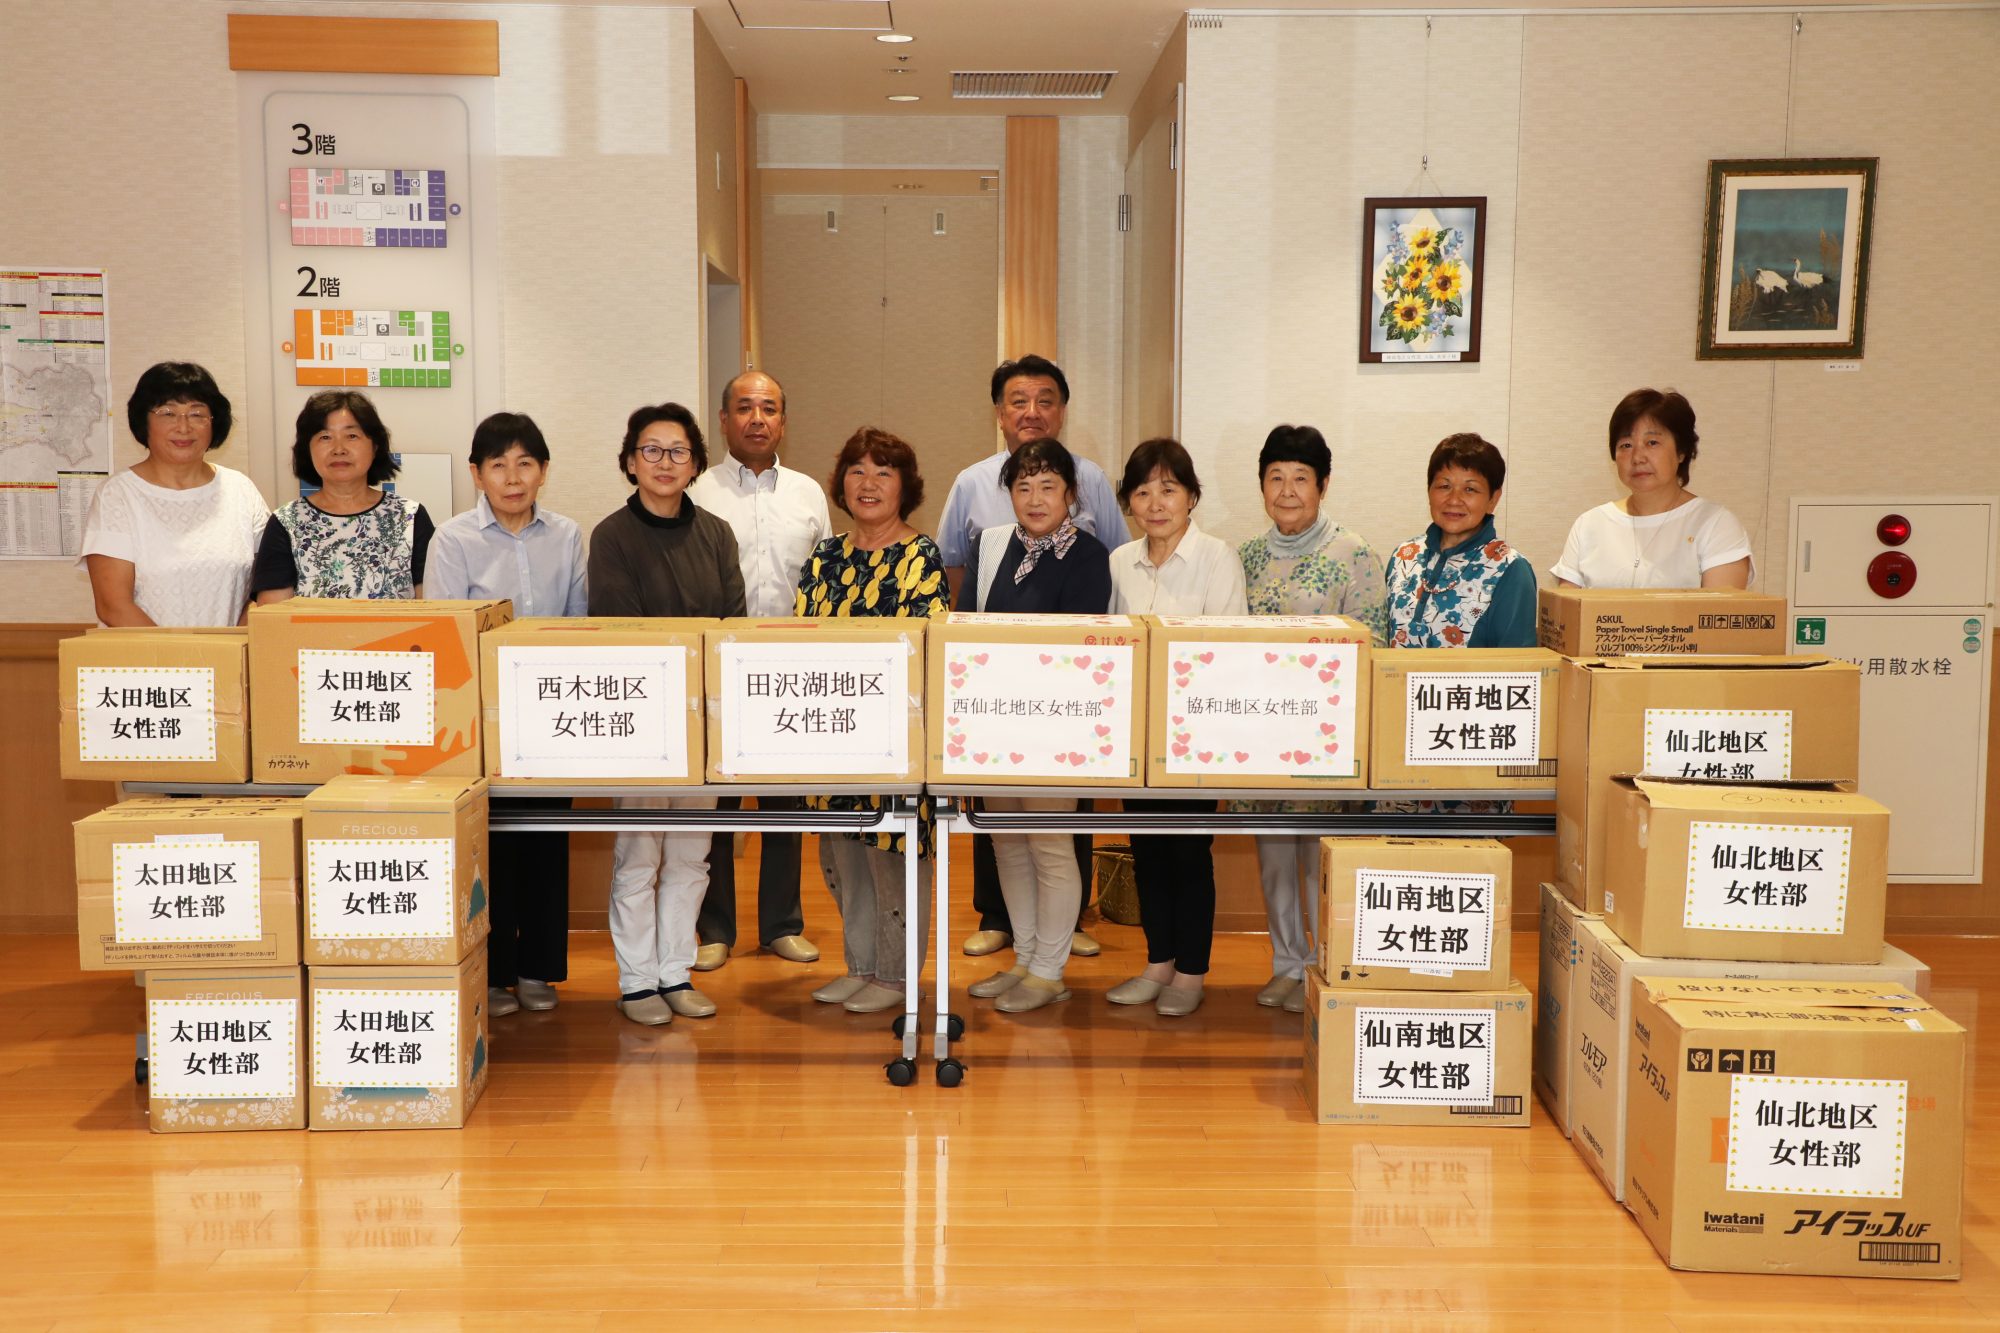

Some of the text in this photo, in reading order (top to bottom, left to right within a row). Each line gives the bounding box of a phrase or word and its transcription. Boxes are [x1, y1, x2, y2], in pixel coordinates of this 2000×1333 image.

[291, 123, 336, 155] 3階
[296, 265, 341, 297] 2階
[1596, 615, 1623, 624] ASKUL
[1596, 625, 1694, 634] Paper Towel Single Small
[1835, 657, 1952, 676] 用散水栓
[317, 668, 413, 692] 太田地区
[537, 674, 648, 700] 西木地区
[747, 671, 885, 697] 田沢湖地区
[96, 686, 192, 708] 太田地区
[951, 697, 1103, 718] 西仙北地区女性部
[1187, 696, 1319, 716] 協和地区女性部
[1415, 683, 1533, 710] 仙南地区
[330, 699, 401, 722] 女性部
[774, 707, 856, 733] 女性部
[110, 717, 182, 739] 女性部
[551, 711, 635, 737] 女性部
[1428, 722, 1517, 750] 女性部
[1665, 729, 1768, 753] 仙北地区
[268, 760, 310, 769] カウネット
[342, 825, 419, 835] FRECIOUS
[1711, 844, 1824, 872] 仙北地区
[135, 861, 238, 885] 太田地区
[328, 859, 429, 882] 太田地区
[342, 891, 418, 915] 女性部
[1362, 879, 1486, 913] 仙南地区
[1723, 879, 1808, 907] 女性部
[149, 894, 226, 919] 女性部
[1377, 923, 1469, 954] 女性部
[170, 1019, 272, 1042] 太田地区
[334, 1009, 435, 1032] 太田地区
[1362, 1019, 1487, 1049] 仙南地区
[183, 1051, 260, 1075] 女性部
[348, 1041, 422, 1064] 女性部
[1377, 1060, 1470, 1090] 女性部
[1755, 1099, 1878, 1129] 仙北地区
[1769, 1138, 1862, 1168] 女性部
[1704, 1211, 1764, 1225] Iwatani
[1704, 1226, 1738, 1234] Materials
[1784, 1210, 1931, 1238] アイラップ UF
